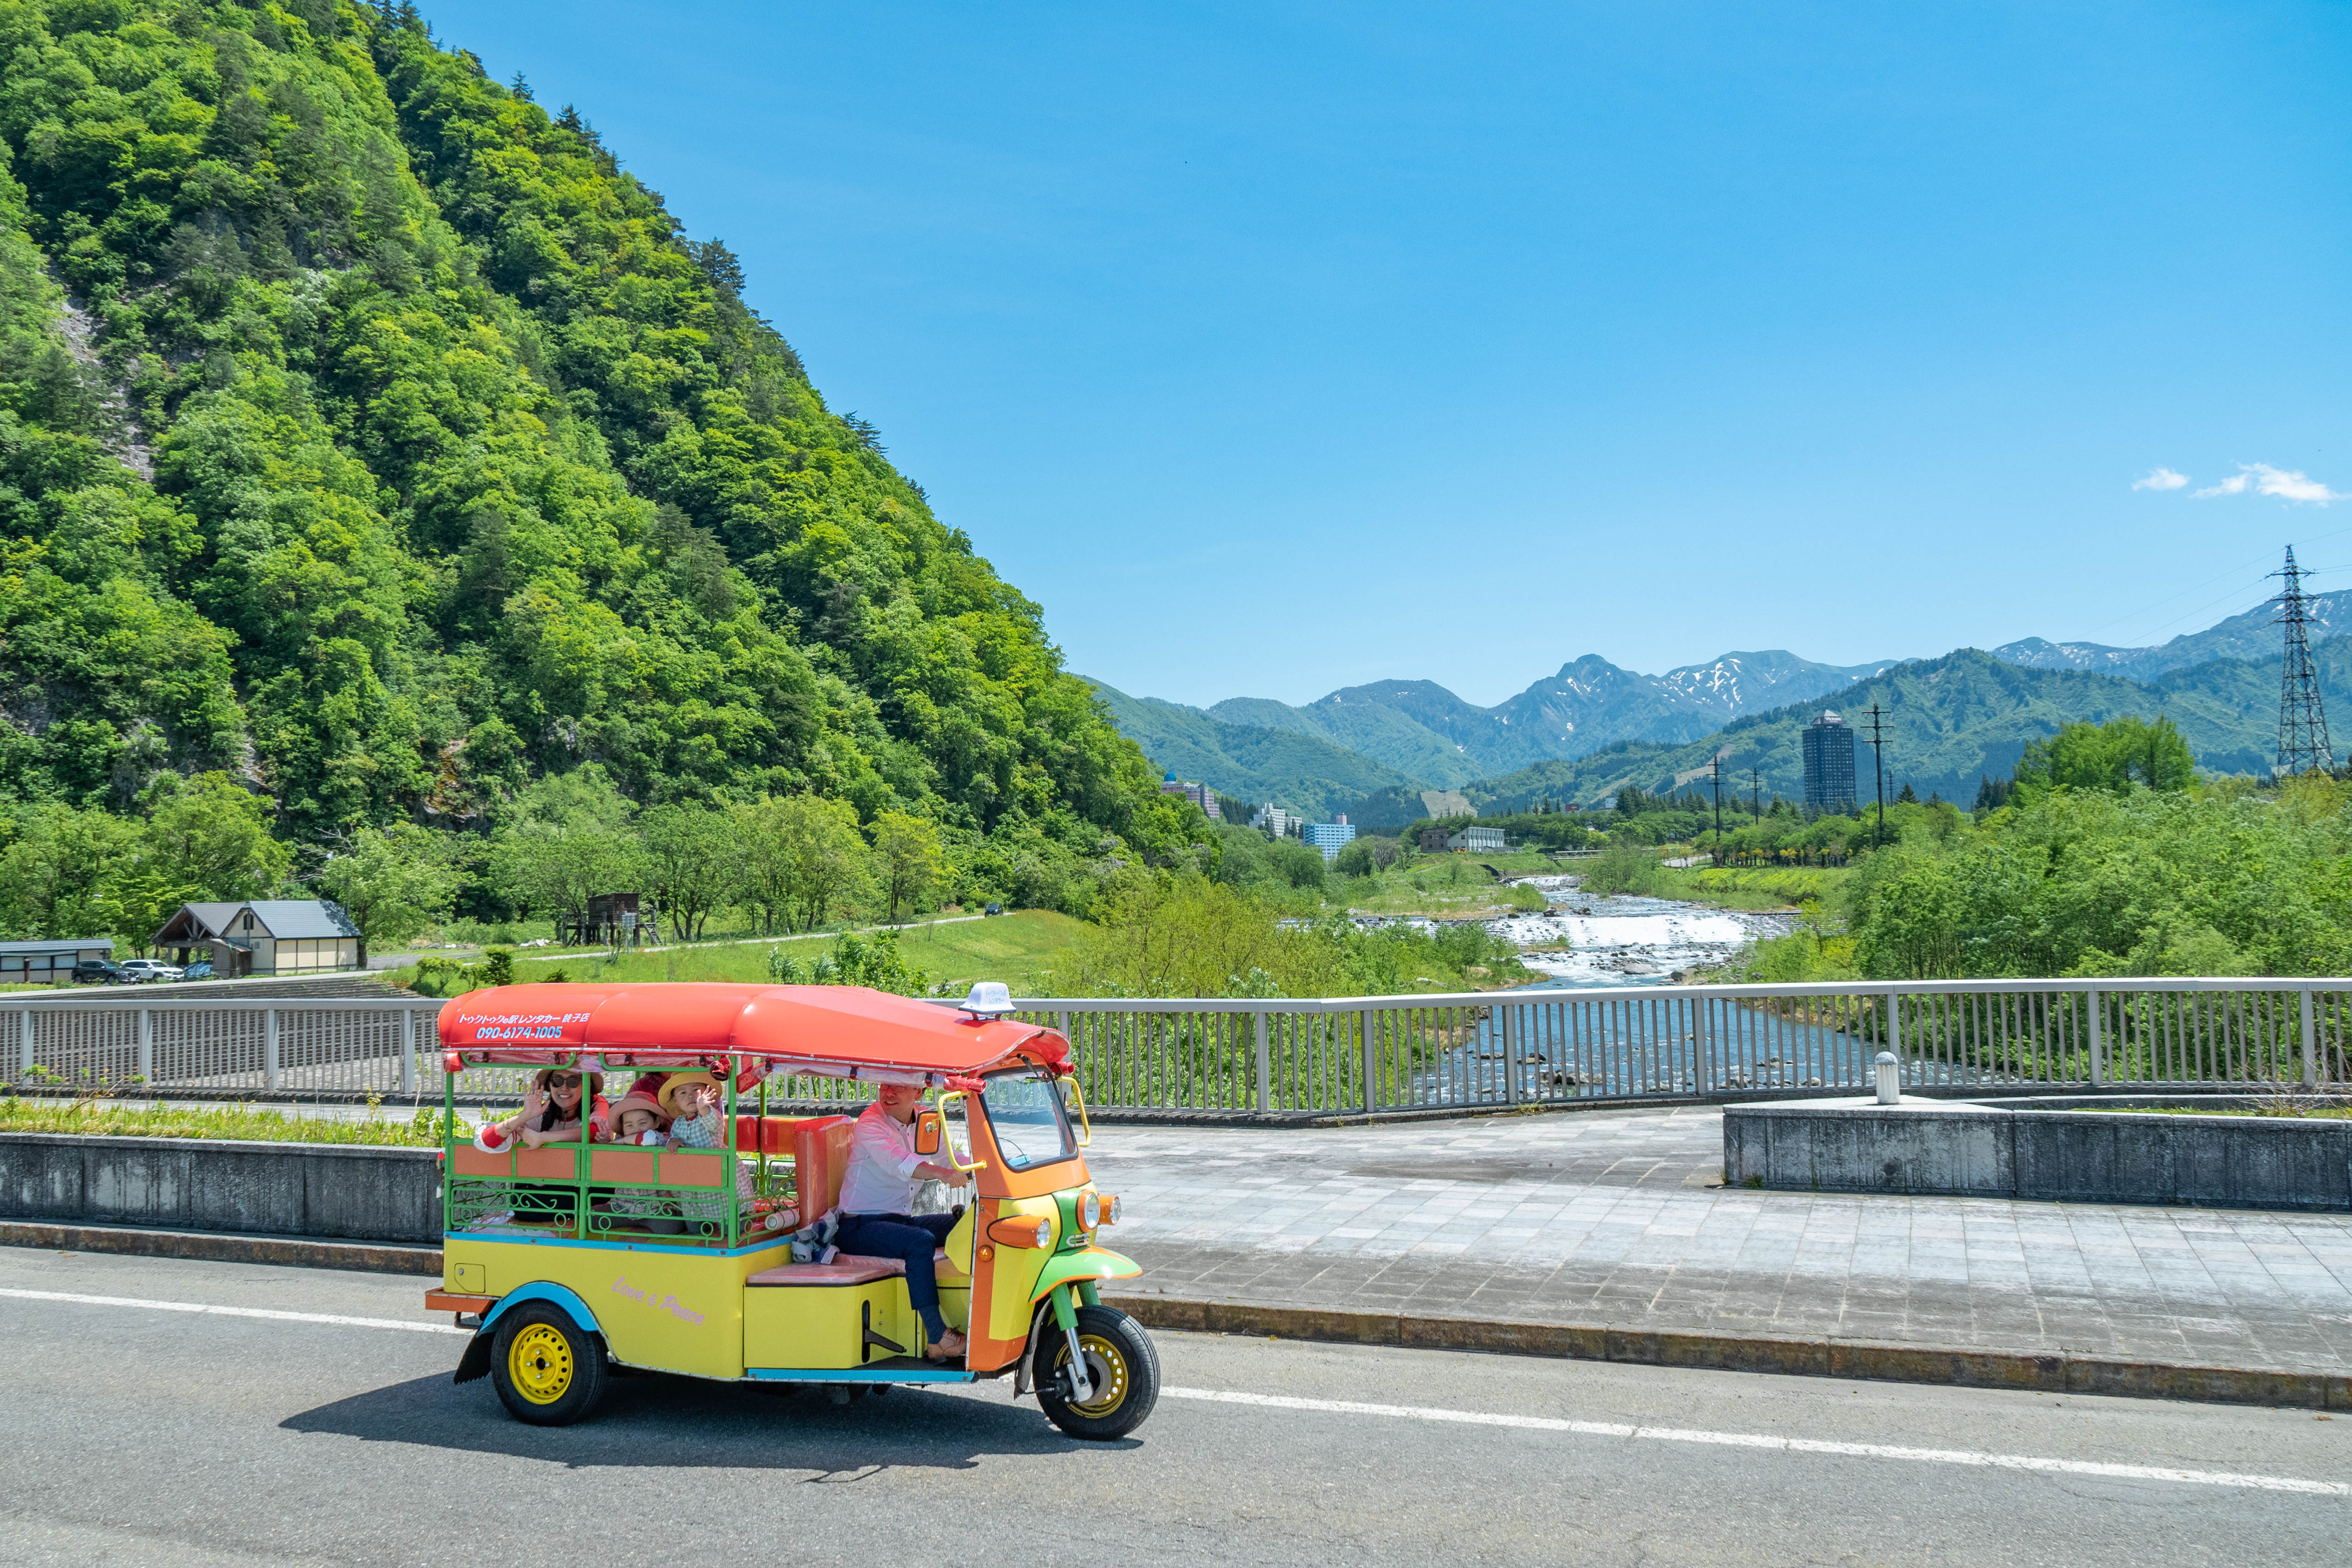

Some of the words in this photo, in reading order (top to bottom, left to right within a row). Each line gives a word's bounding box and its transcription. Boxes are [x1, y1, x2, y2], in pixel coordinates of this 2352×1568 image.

[476, 1026, 563, 1039] 090-6174-1005
[612, 1275, 645, 1302] Love
[659, 1295, 705, 1326] Peace
